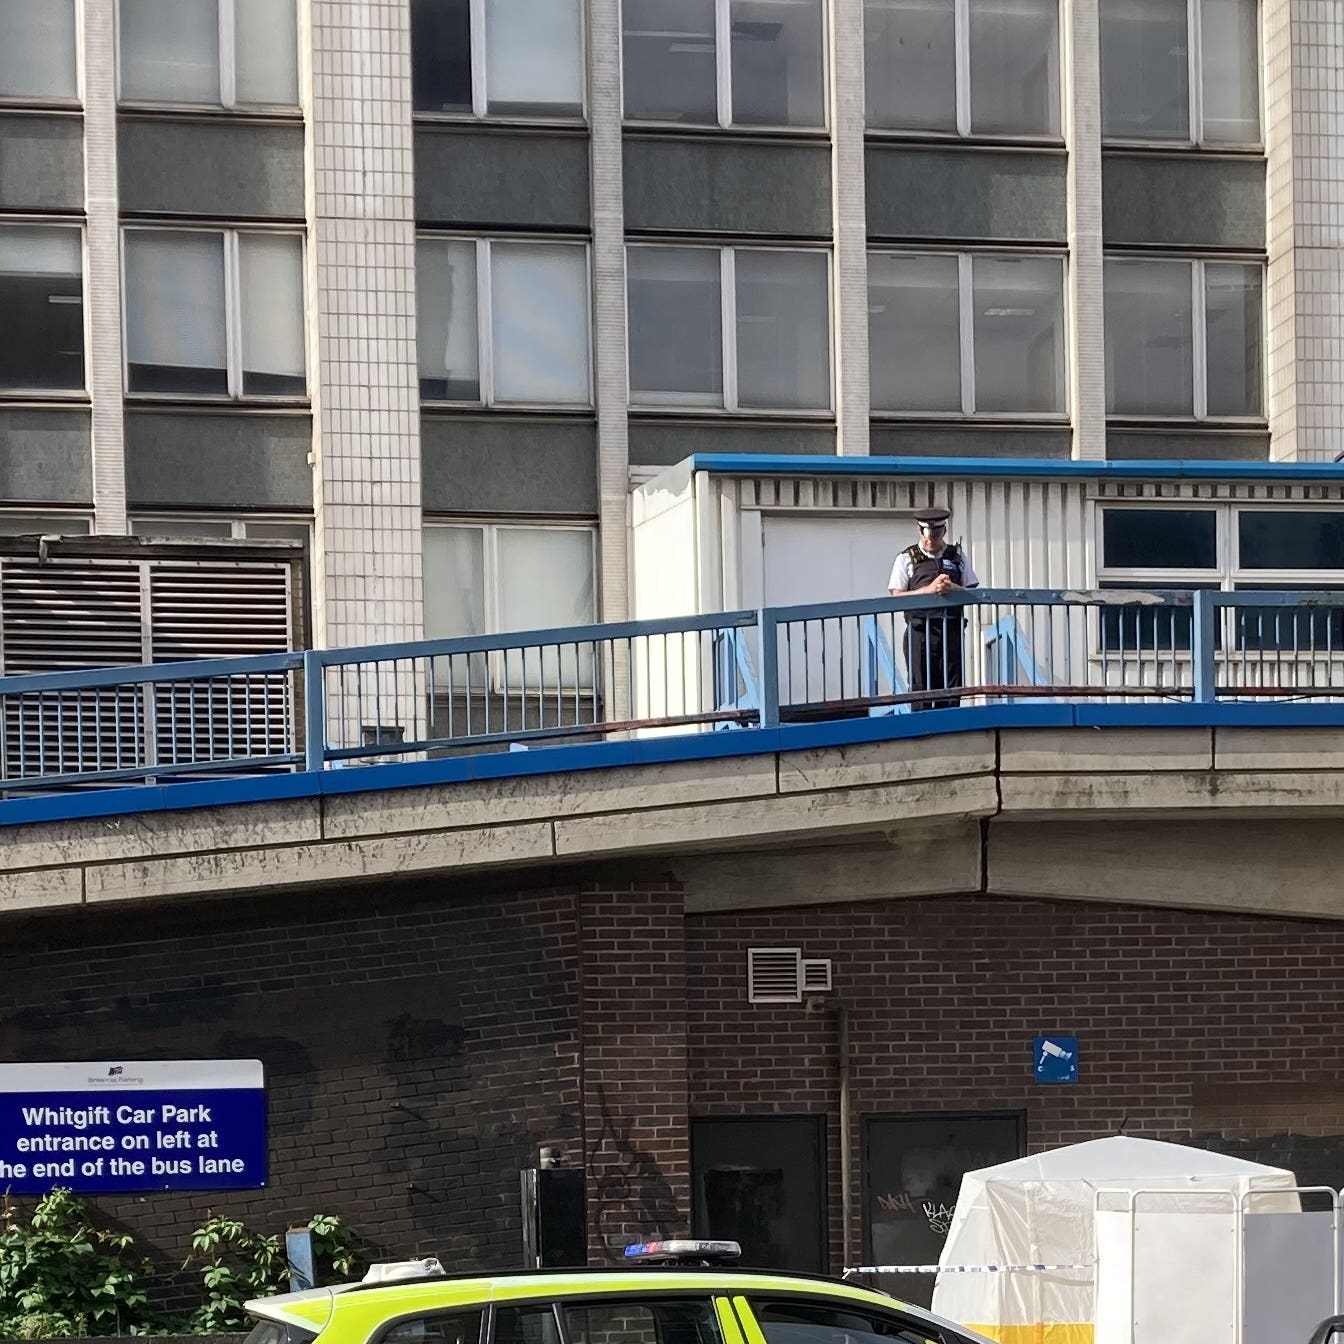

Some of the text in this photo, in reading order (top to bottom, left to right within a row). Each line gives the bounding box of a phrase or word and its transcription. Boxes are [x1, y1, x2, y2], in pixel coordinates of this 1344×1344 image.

[22, 1104, 212, 1129] Whitgift Car Park
[16, 1130, 219, 1152] entrance on left at
[32, 1159, 75, 1177] end
[81, 1158, 104, 1176] of
[110, 1157, 145, 1175] the
[152, 1157, 192, 1175] bus
[199, 1155, 245, 1174] lane
